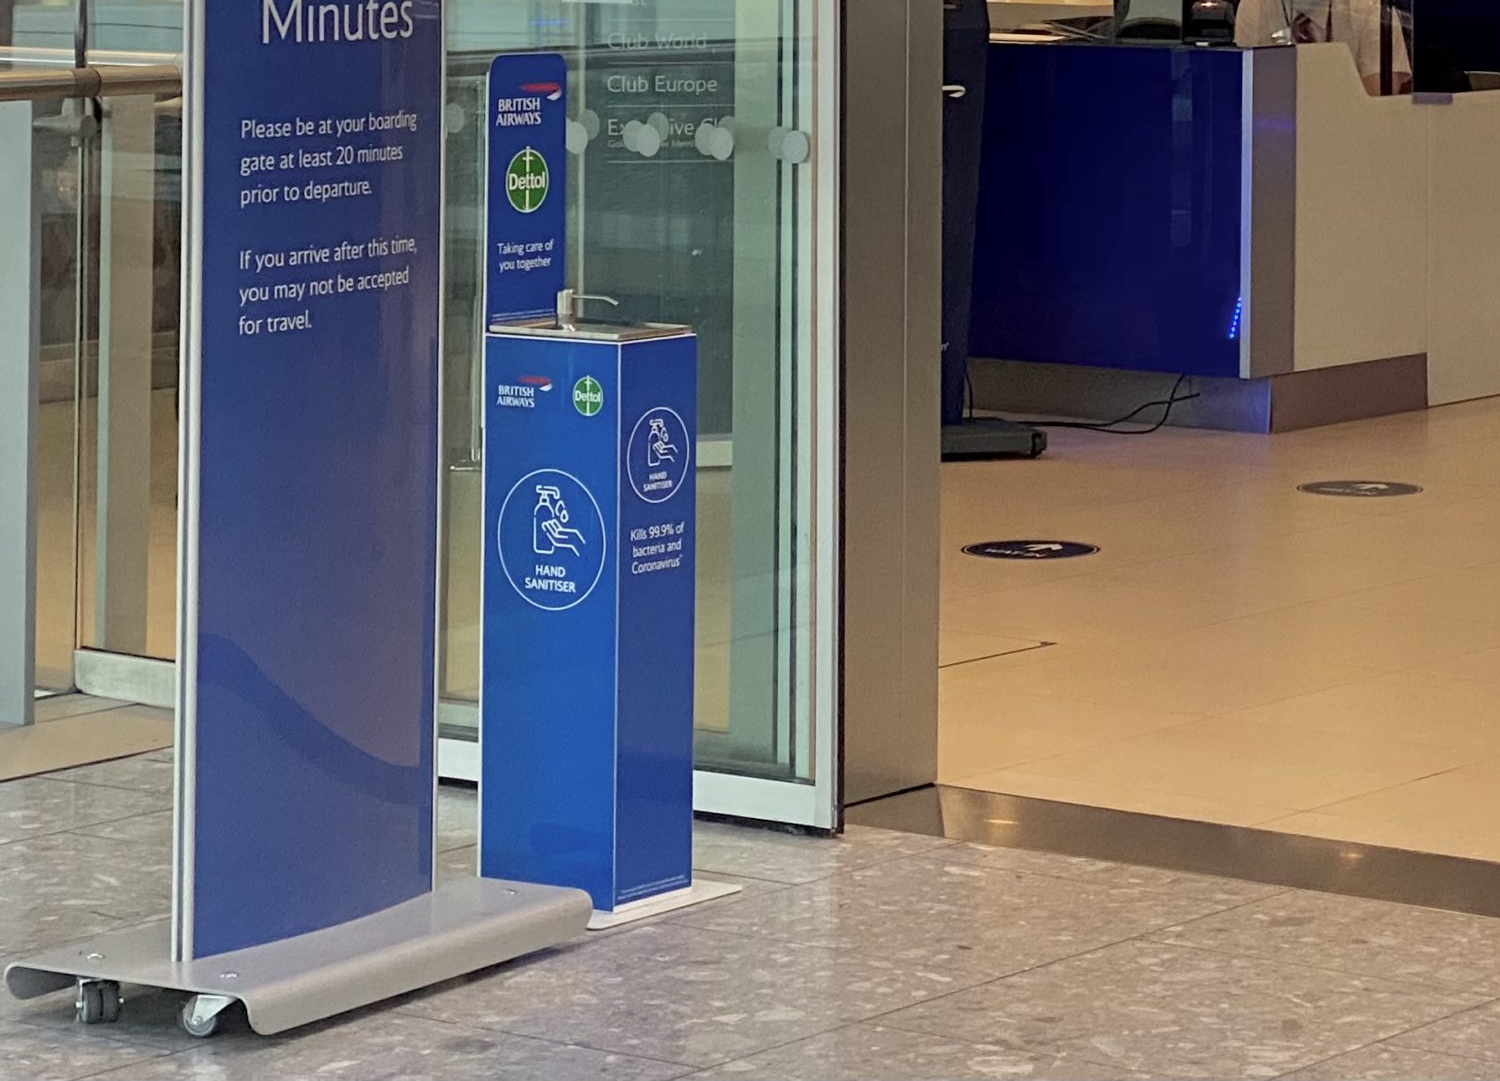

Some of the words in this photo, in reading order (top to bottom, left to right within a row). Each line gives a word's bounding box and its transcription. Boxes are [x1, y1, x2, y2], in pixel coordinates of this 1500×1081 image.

[607, 32, 648, 50] Club
[655, 32, 708, 50] World
[607, 75, 649, 93] Club
[654, 76, 719, 96] Europe
[498, 98, 541, 112] BRITISH
[241, 119, 292, 139] Please
[296, 117, 315, 136] be
[318, 118, 333, 135] at
[336, 117, 366, 138] your
[368, 109, 418, 132] boarding
[495, 112, 542, 126] AIRWAYS
[240, 154, 275, 177] gate
[279, 152, 295, 169] at
[299, 149, 333, 168] least
[336, 145, 354, 166] 20
[357, 143, 404, 163] minutes
[508, 171, 546, 191] Dettol
[240, 184, 279, 209] prior
[283, 185, 300, 201] to
[304, 179, 373, 203] departure.
[239, 249, 252, 270] If
[255, 251, 285, 273] you
[289, 244, 330, 266] arrive
[333, 241, 366, 262] after
[367, 238, 389, 258] this
[391, 234, 418, 255] time,
[497, 242, 525, 256] Taking
[525, 240, 544, 253] care
[544, 238, 555, 252] of
[498, 260, 516, 274] you
[516, 256, 552, 271] together
[239, 286, 269, 307] you
[273, 282, 306, 302] may
[309, 278, 335, 296] not
[337, 273, 354, 293] be
[357, 265, 410, 291] accepted
[238, 315, 263, 336] for
[267, 309, 313, 333] travel.
[497, 385, 535, 397] BRITISH
[574, 389, 602, 403] Dettol
[496, 396, 536, 408] AIRWAYS
[648, 471, 668, 481] HAND
[642, 480, 673, 493] SANITISER
[630, 528, 648, 542] Kills
[648, 523, 675, 539] 99.9%
[675, 521, 685, 535] of
[632, 541, 665, 558] bacteria
[666, 538, 682, 552] and
[535, 564, 566, 578] HAND
[524, 577, 577, 594] SANITISER
